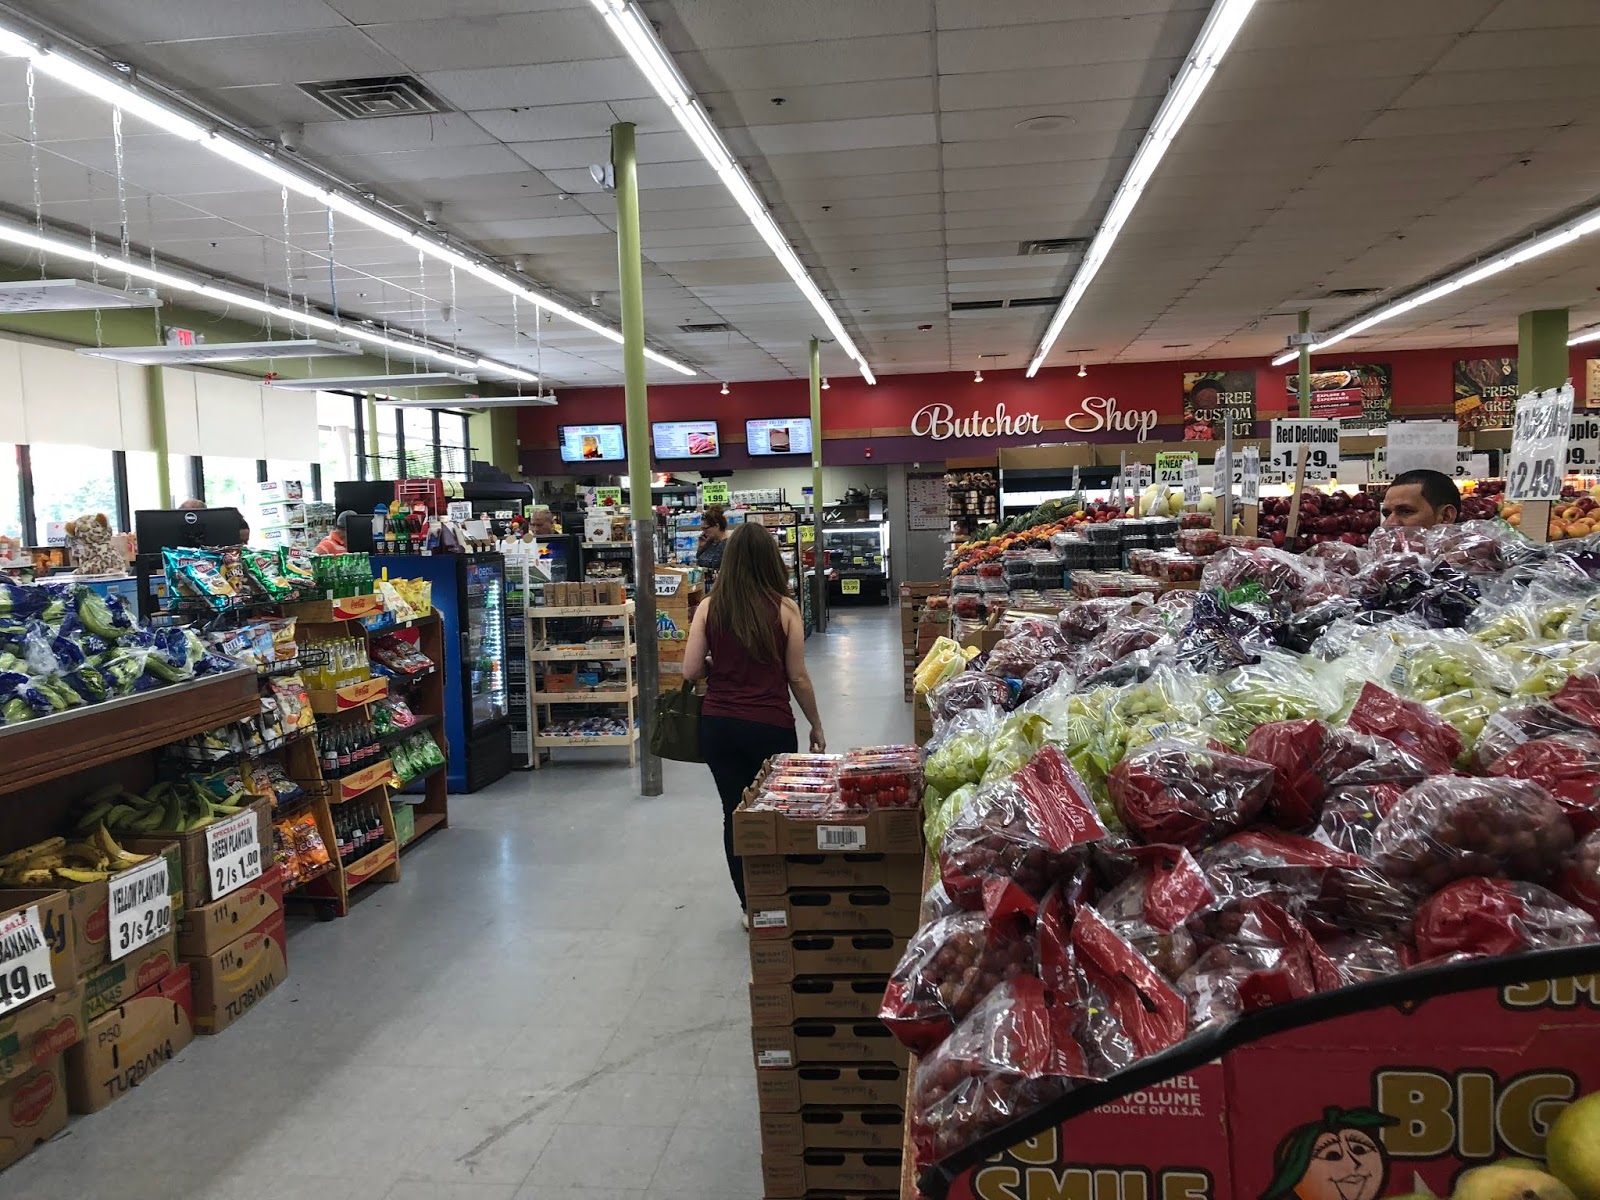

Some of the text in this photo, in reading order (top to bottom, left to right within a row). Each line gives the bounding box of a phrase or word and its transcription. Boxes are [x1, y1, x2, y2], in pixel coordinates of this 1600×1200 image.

[1216, 391, 1252, 405] FREE
[1484, 400, 1517, 412] GREA
[911, 396, 1158, 443] Butcher Shop
[1195, 408, 1252, 421] CUSTOM
[1471, 415, 1514, 427] TASTI
[1277, 425, 1338, 443] Red Delicious
[1569, 421, 1599, 441] pple
[1510, 459, 1555, 498] $2.49
[212, 818, 250, 839] SPECIAL SALE
[211, 826, 253, 862] GREEN PLANTAIN
[112, 870, 165, 915] YELLOW PLANTAIN
[213, 904, 228, 923] 111
[4, 915, 28, 932] SALE
[0, 925, 42, 964] ANANA
[219, 951, 235, 971] 111
[33, 973, 52, 991] lb.
[224, 973, 275, 1021] TURBANA
[104, 1039, 174, 1098] TURBANA
[1156, 1076, 1199, 1090] SHEL
[1122, 1092, 1201, 1106] VOLUME
[1095, 1105, 1205, 1116] RODUCE OF U.S.A.
[1378, 1071, 1577, 1158] BIG
